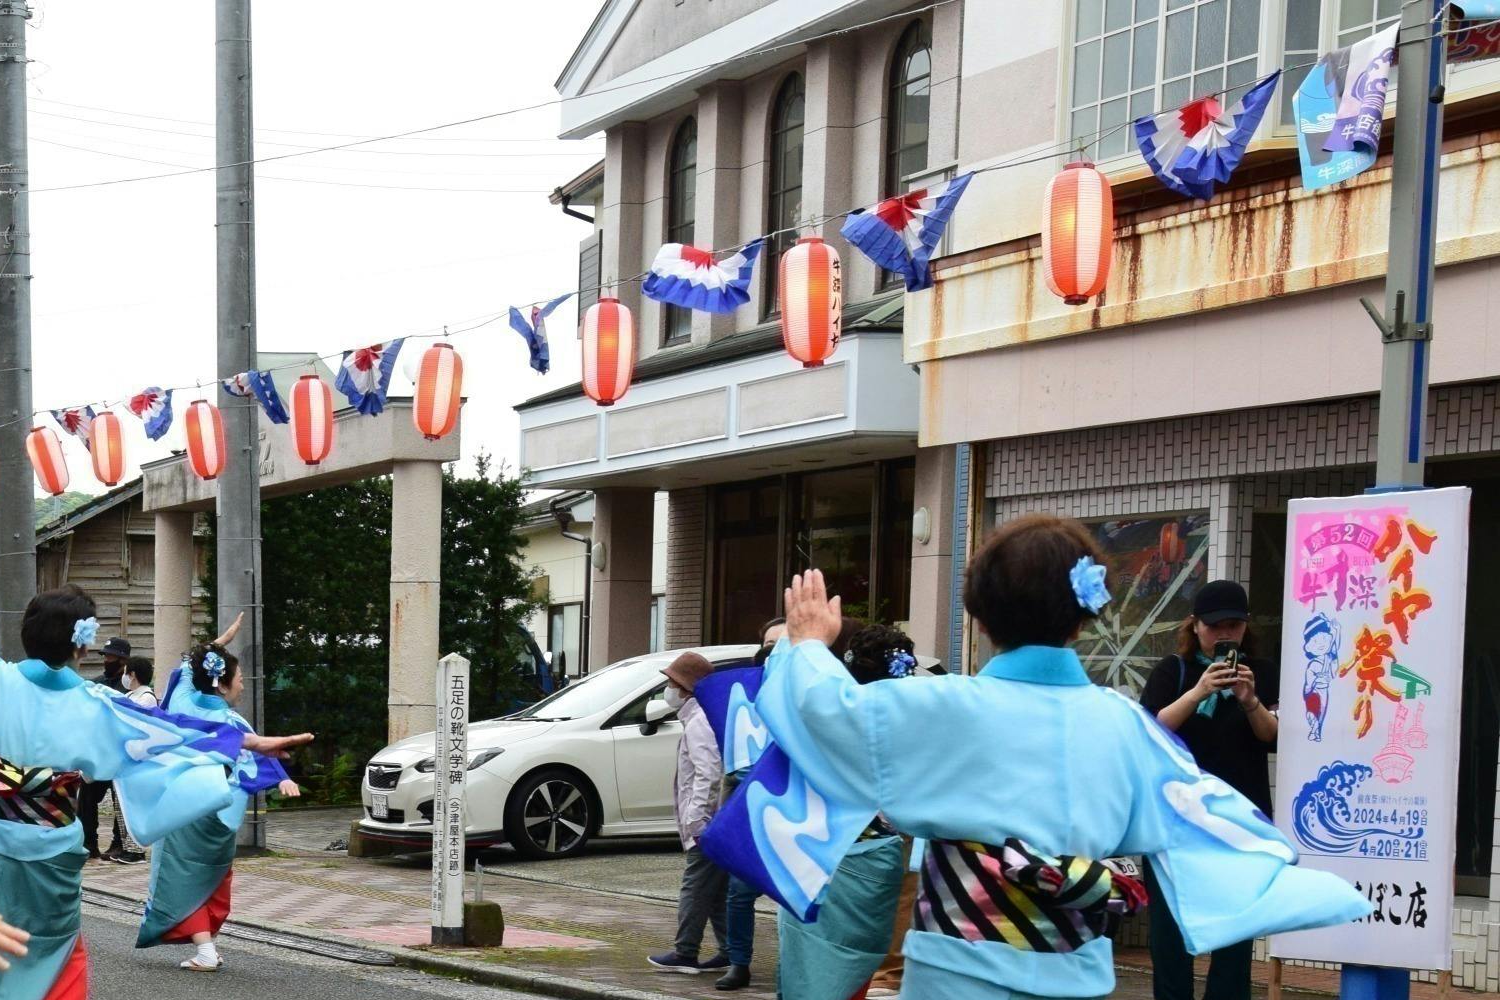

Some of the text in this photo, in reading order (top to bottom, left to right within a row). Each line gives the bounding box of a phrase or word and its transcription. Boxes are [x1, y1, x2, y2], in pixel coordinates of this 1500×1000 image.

[1309, 524, 1375, 552] 第52回
[449, 675, 465, 784] 五足の靴文学碑
[1338, 624, 1402, 740] 祭り
